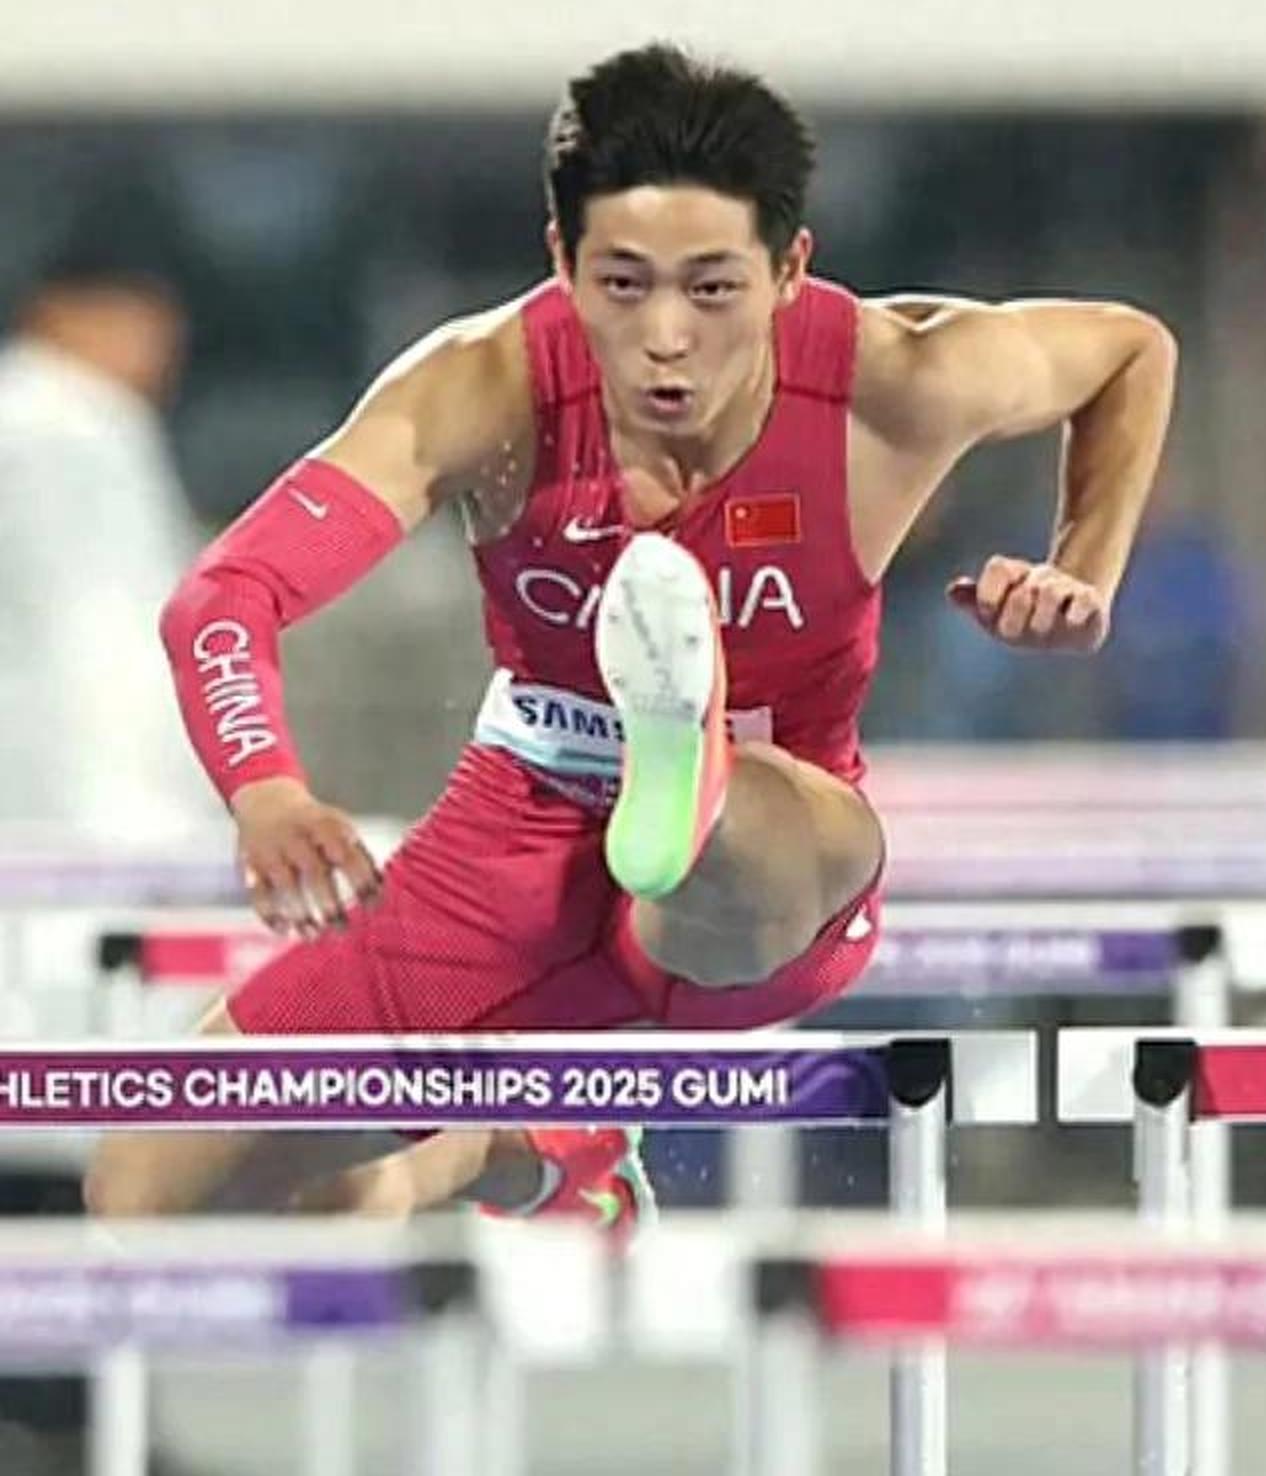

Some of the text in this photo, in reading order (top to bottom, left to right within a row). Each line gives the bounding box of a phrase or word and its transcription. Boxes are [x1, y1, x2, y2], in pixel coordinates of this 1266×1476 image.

[193, 619, 277, 767] CHINA
[183, 1067, 553, 1108] CHAMPIONSHIPS
[562, 1068, 663, 1107] 2025
[671, 1067, 790, 1106] GUMI
